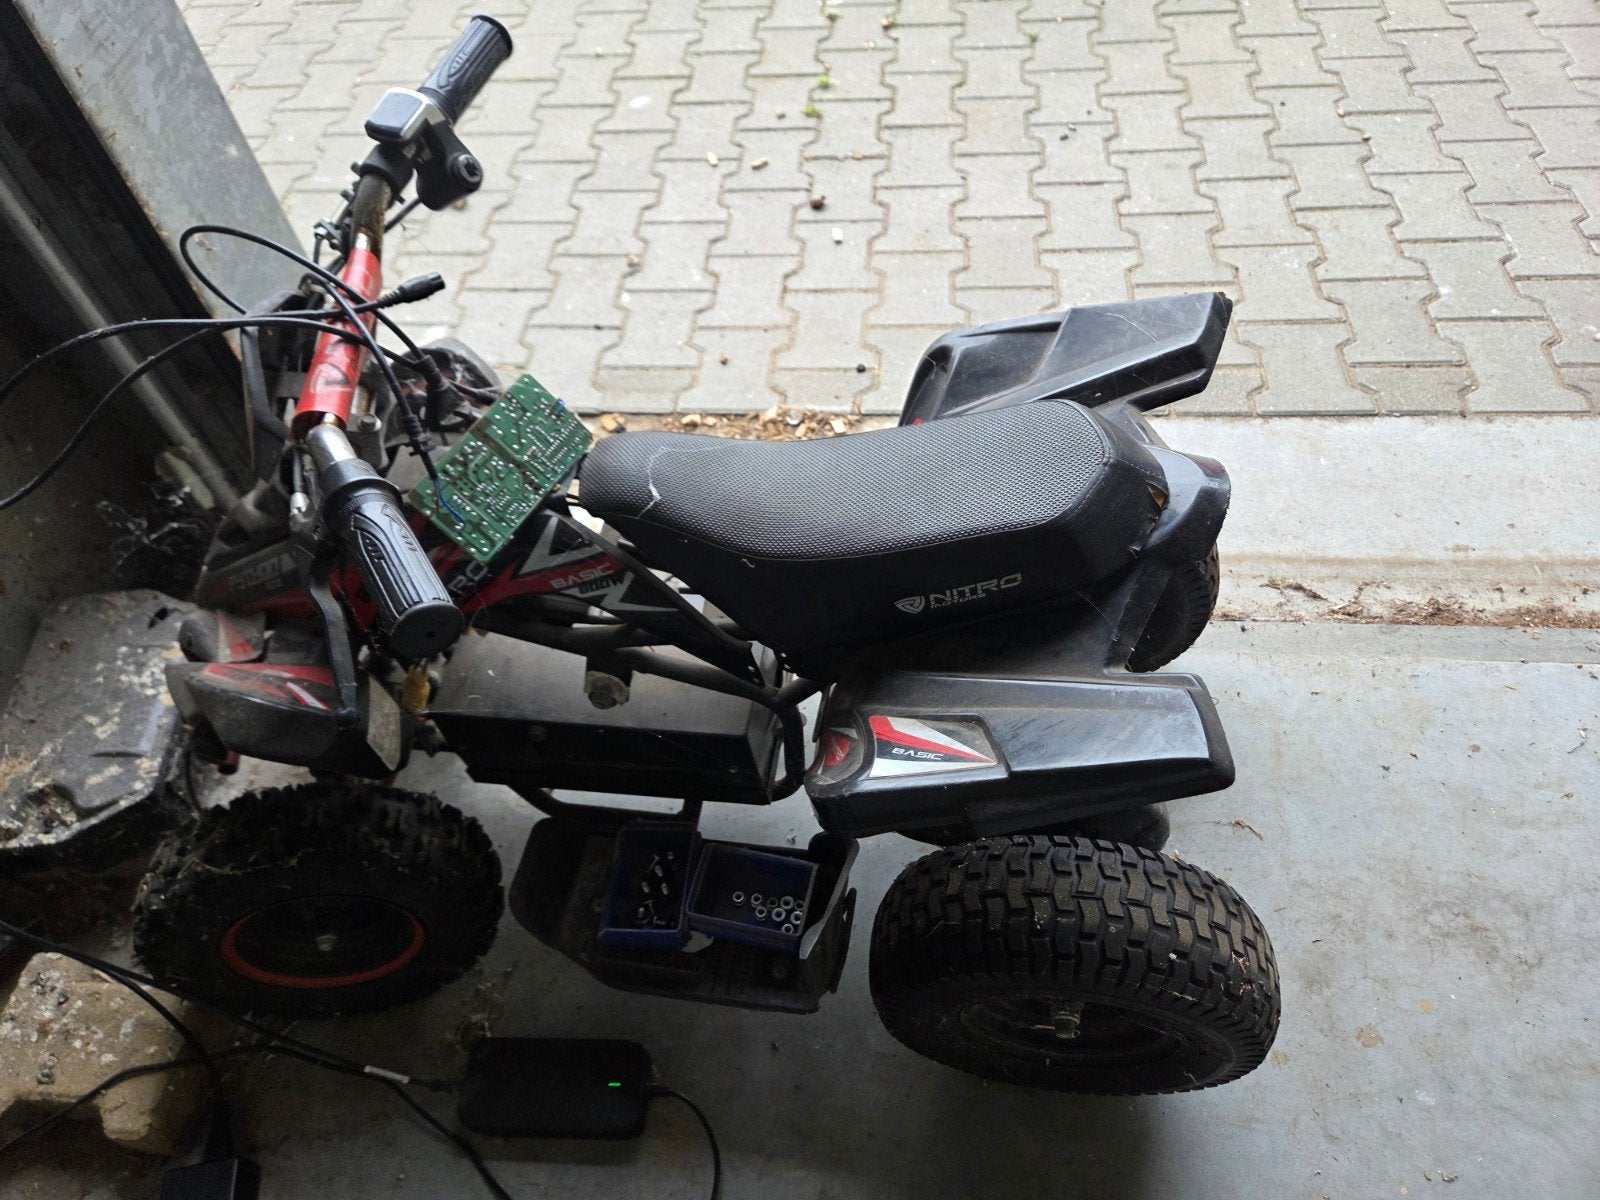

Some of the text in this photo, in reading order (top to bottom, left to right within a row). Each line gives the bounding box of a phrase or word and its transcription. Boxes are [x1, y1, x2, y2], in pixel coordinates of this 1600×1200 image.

[551, 562, 614, 589] BASIC
[928, 573, 1022, 604] NITRO
[891, 747, 944, 761] BASIC
